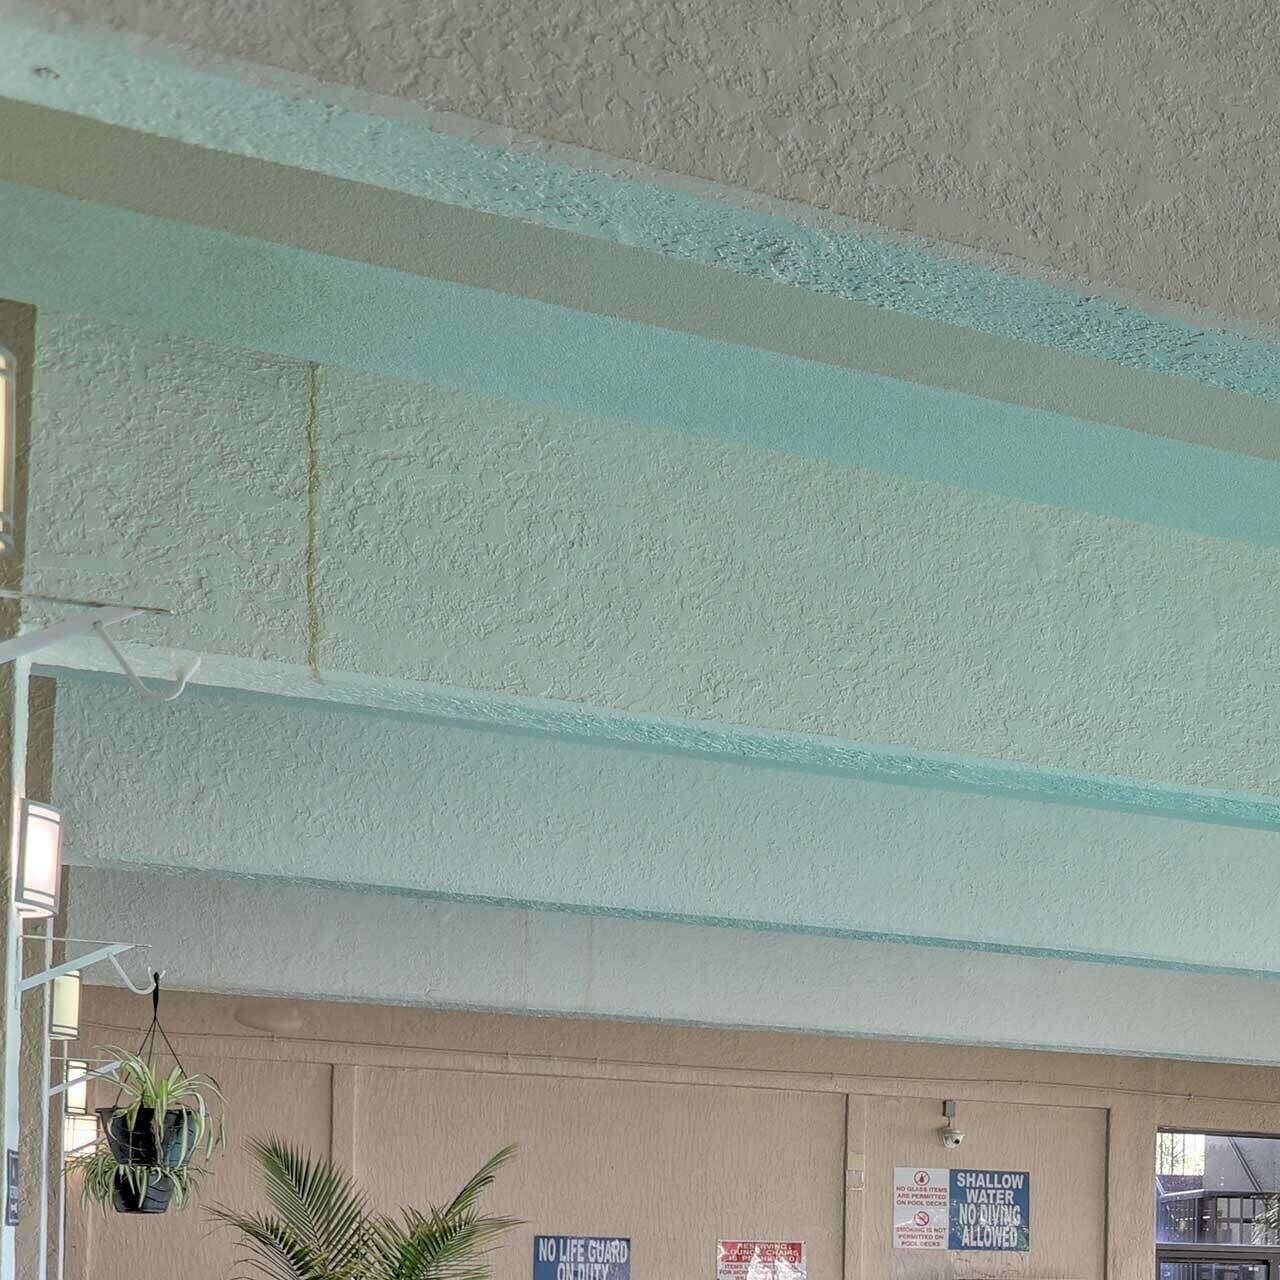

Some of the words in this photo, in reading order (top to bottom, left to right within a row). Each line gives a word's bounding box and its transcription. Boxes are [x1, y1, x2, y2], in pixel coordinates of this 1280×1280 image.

[957, 1172, 1024, 1189] SHALLOW
[966, 1188, 1014, 1205] WATER
[959, 1203, 976, 1225] NO
[980, 1204, 1021, 1227] DIVING
[961, 1225, 1018, 1248] ALLOWED
[539, 1238, 556, 1262] NO
[560, 1238, 585, 1262] LIFE
[588, 1239, 628, 1263] GUARD
